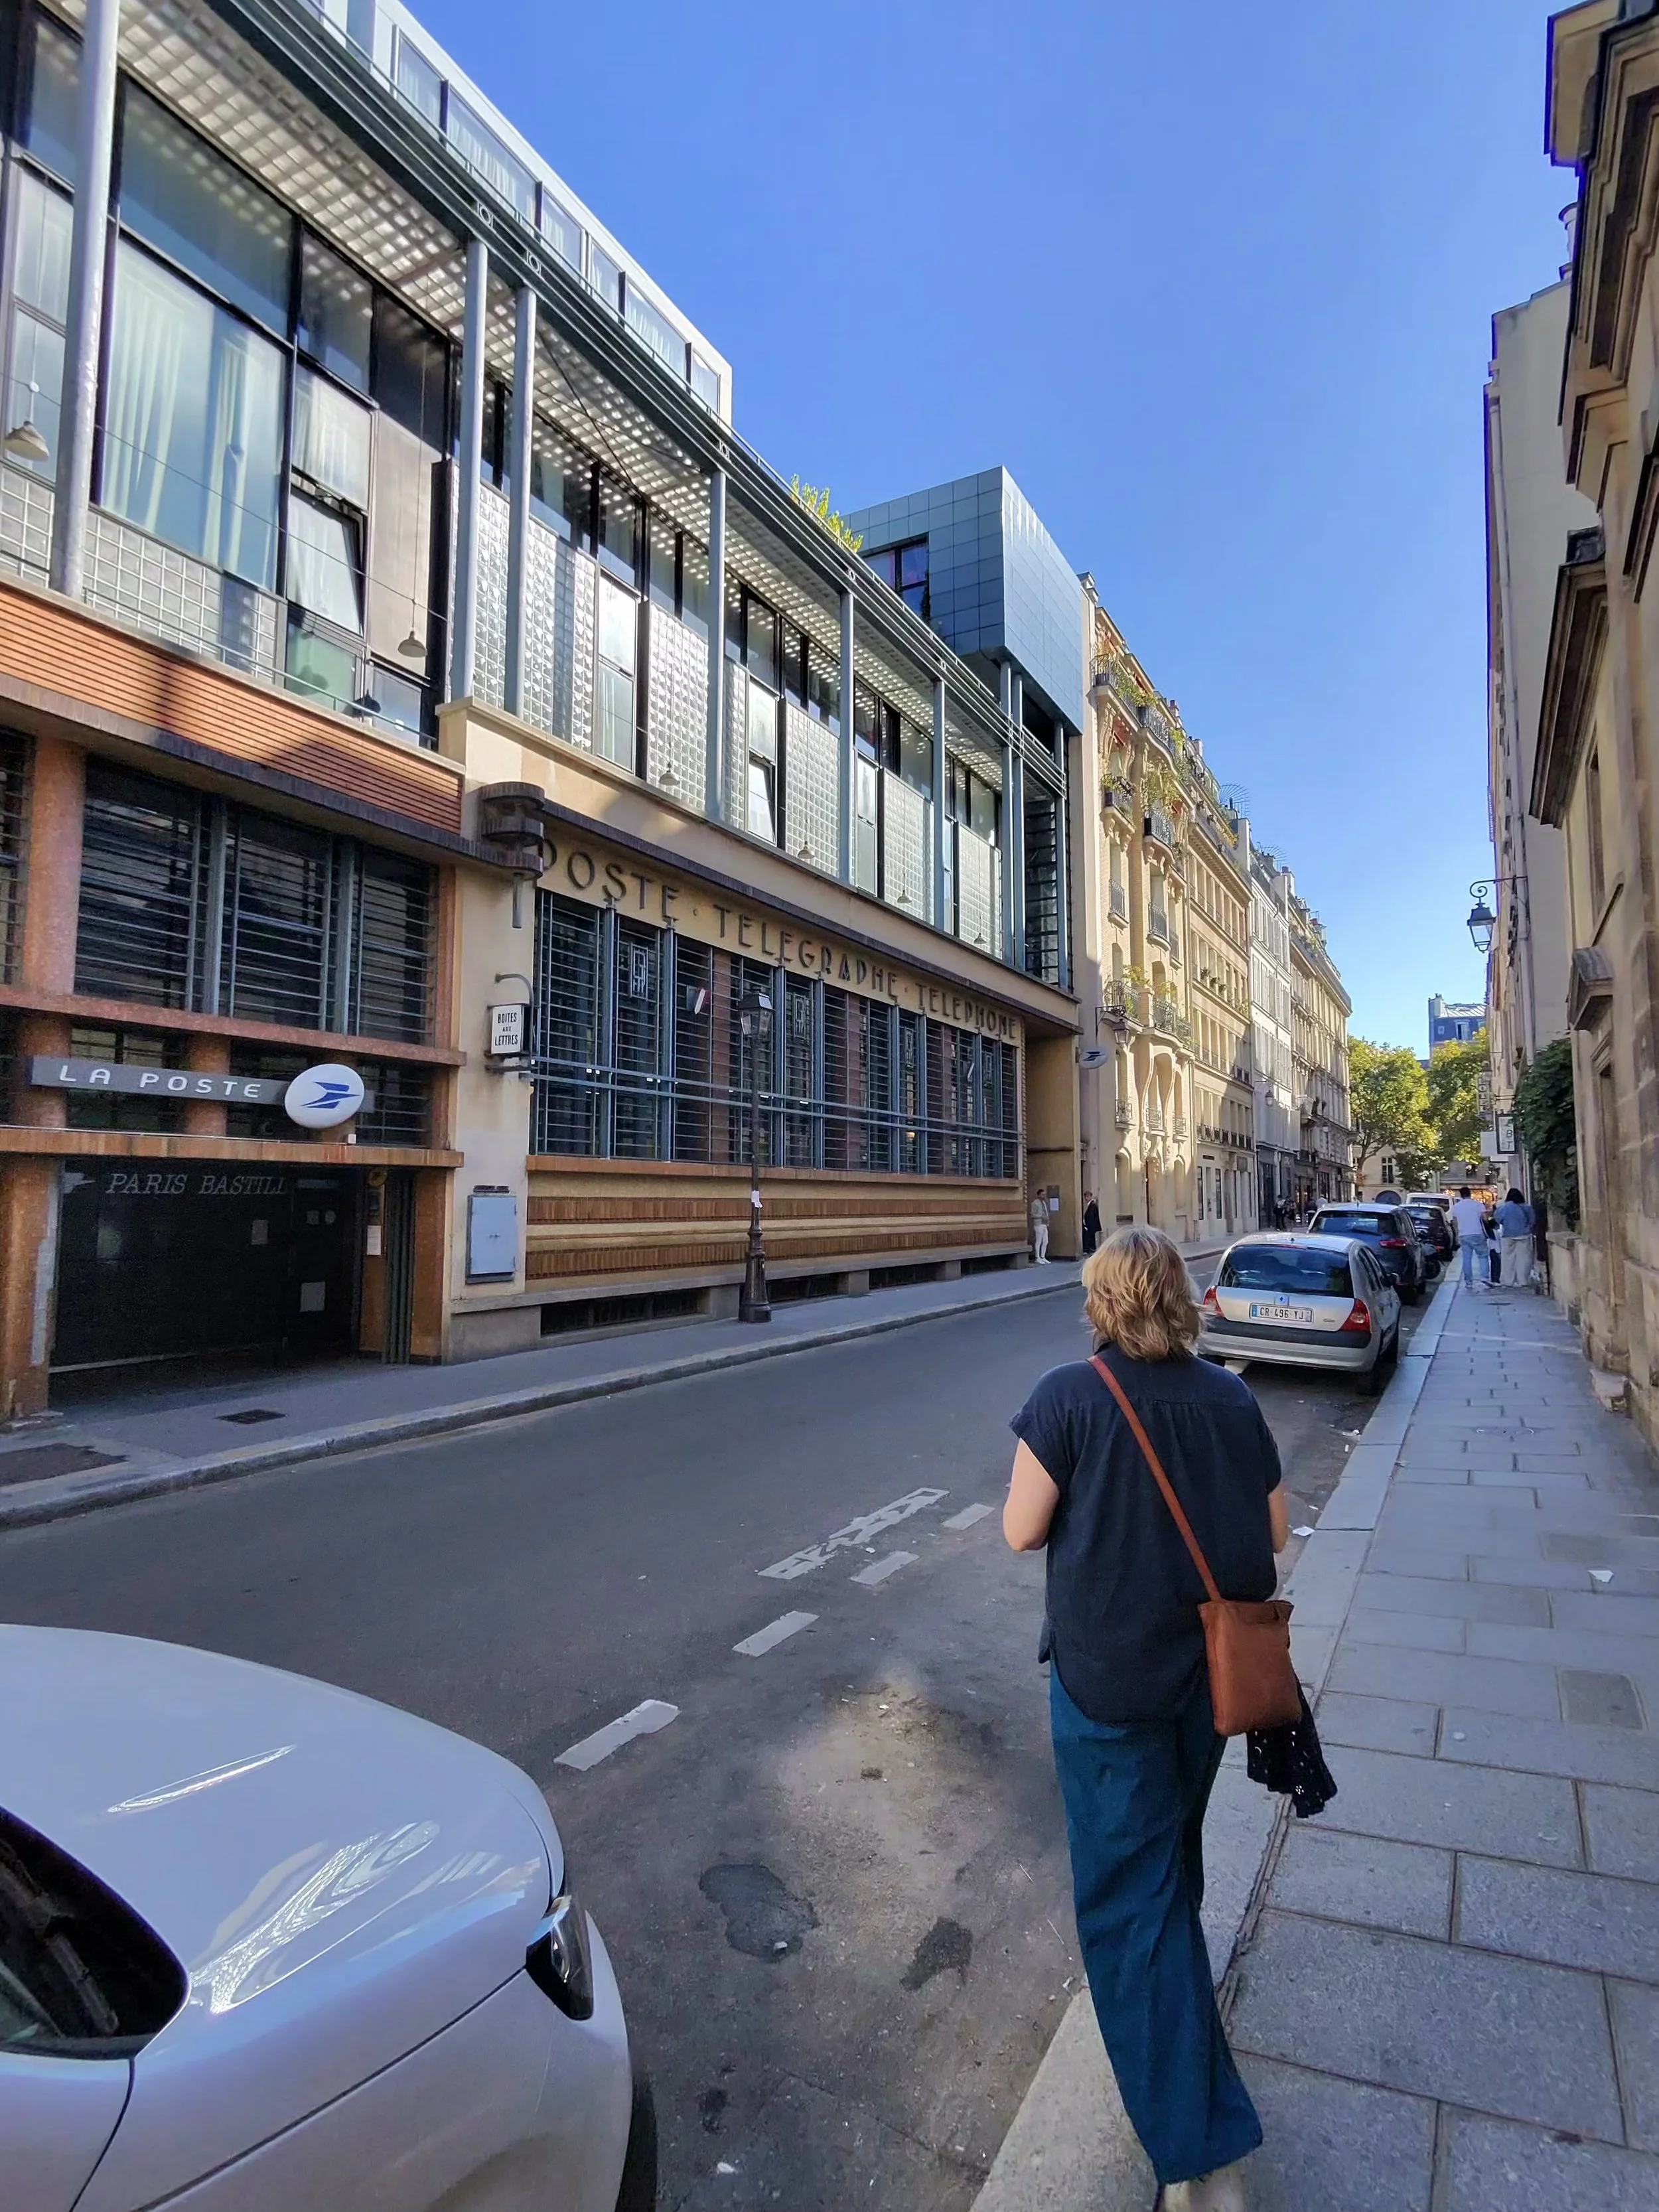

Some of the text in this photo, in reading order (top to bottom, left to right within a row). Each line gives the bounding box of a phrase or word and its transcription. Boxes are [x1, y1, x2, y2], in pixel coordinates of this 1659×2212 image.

[498, 1012, 517, 1023] BOITES
[494, 1034, 518, 1046] LETTRES
[59, 1065, 261, 1098] LA POSTE
[106, 1173, 188, 1194] PARIS
